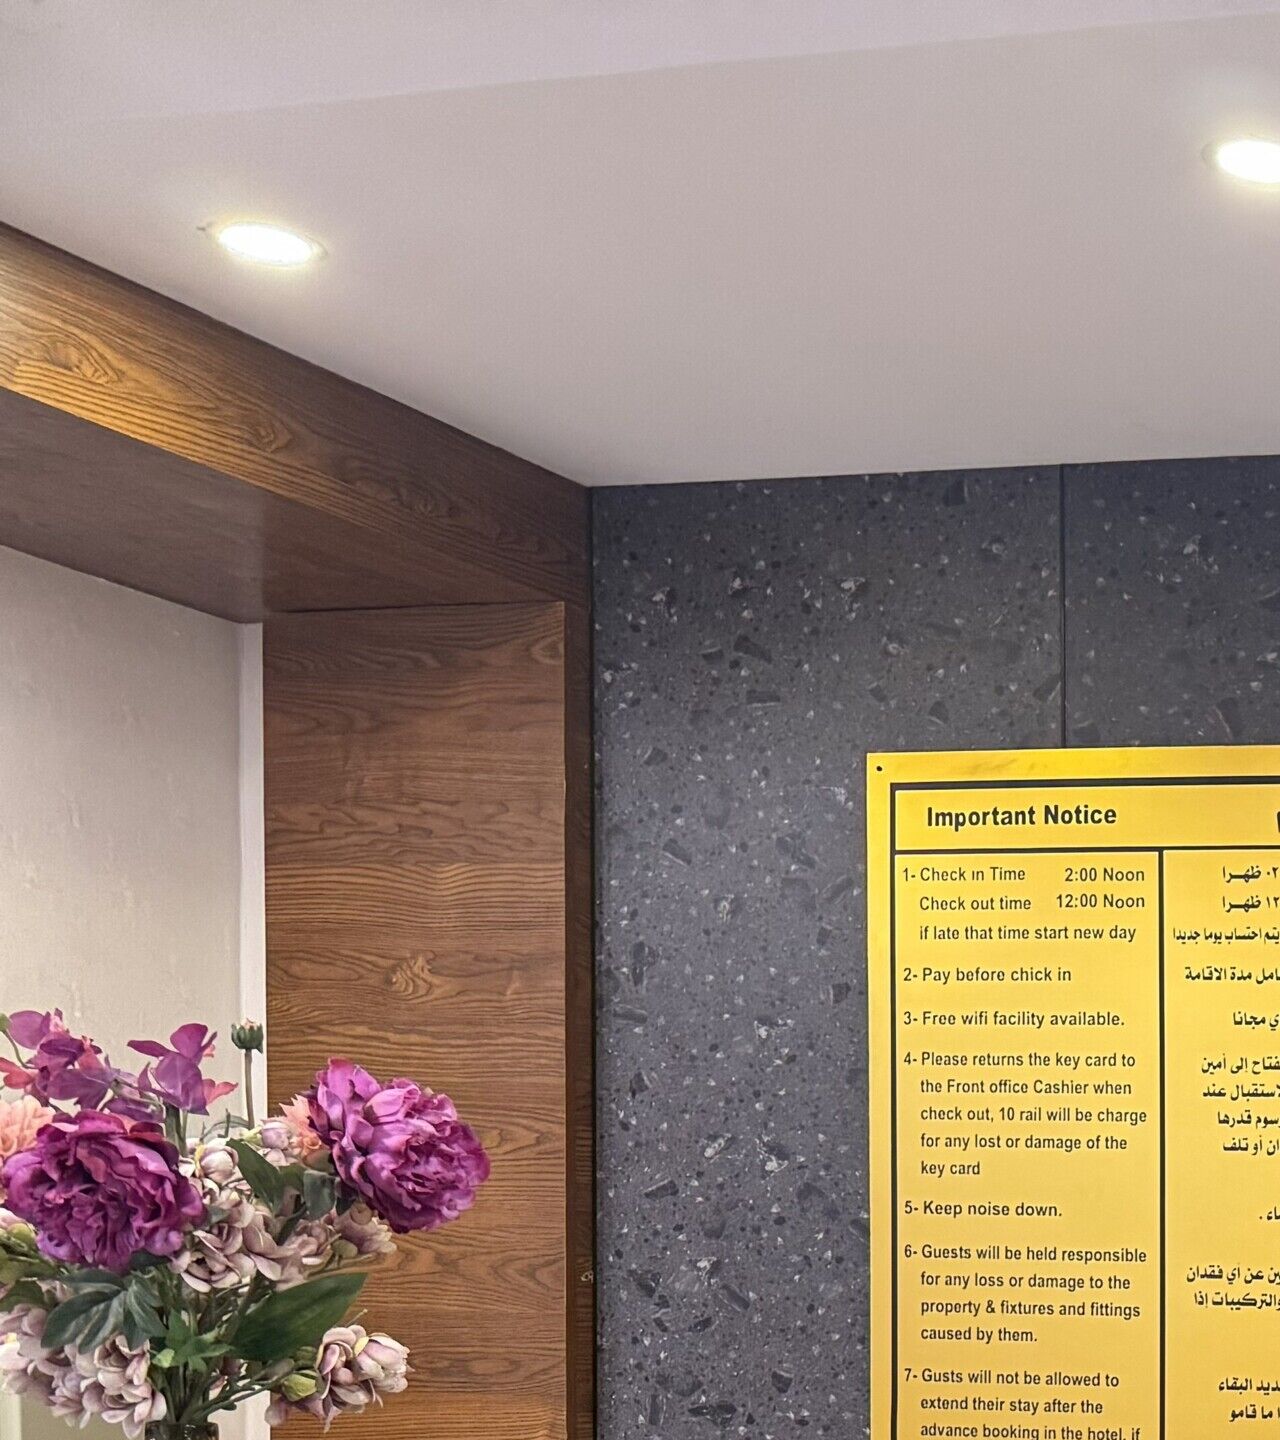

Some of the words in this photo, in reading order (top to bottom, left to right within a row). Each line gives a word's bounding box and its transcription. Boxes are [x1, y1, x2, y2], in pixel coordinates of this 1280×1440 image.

[927, 805, 1036, 833] Important
[1043, 803, 1117, 825] Notice
[919, 866, 967, 882] Check
[971, 870, 985, 881] in
[989, 866, 1026, 881] Time
[1064, 867, 1098, 883] 2:00
[1103, 867, 1145, 882] Noon
[919, 895, 966, 911] Check
[970, 897, 995, 911] out
[999, 895, 1032, 911] time
[1056, 893, 1098, 909] 12:00
[1103, 893, 1145, 909] Noon
[919, 925, 930, 941] if
[933, 925, 960, 940] late
[964, 925, 994, 940] that
[997, 925, 1030, 940] time
[1034, 926, 1069, 940] start
[1073, 928, 1105, 940] new
[1108, 924, 1137, 943] day
[922, 967, 951, 986] Pay
[956, 966, 1006, 982] before
[1010, 966, 1053, 982] chick
[1057, 966, 1072, 982] in
[922, 1010, 957, 1026] Free
[960, 1010, 988, 1026] wifi
[993, 1010, 1045, 1030] facility
[1049, 1011, 1125, 1026] available.
[1232, 1010, 1267, 1030] مجانا
[921, 1051, 968, 1067] Please
[972, 1052, 1024, 1067] returns
[1028, 1051, 1051, 1067] the
[1055, 1051, 1081, 1071] key
[1084, 1052, 1117, 1067] card
[1121, 1053, 1136, 1068] to
[920, 1078, 943, 1093] the
[947, 1078, 985, 1094] Front
[989, 1078, 1029, 1094] office
[1033, 1079, 1090, 1095] Cashier
[1092, 1080, 1132, 1095] when
[1202, 1083, 1227, 1098] عند
[920, 1105, 963, 1121] check
[966, 1107, 994, 1123] out,
[998, 1106, 1015, 1121] 10
[1019, 1106, 1042, 1122] rail
[1046, 1106, 1071, 1122] will
[1075, 1107, 1093, 1122] be
[1097, 1107, 1147, 1127] charge
[920, 1133, 941, 1148] for
[944, 1136, 971, 1152] any
[974, 1133, 1002, 1149] lost
[1005, 1137, 1021, 1149] or
[1024, 1134, 1082, 1153] damage
[1086, 1134, 1102, 1150] of
[1104, 1135, 1128, 1150] the
[920, 1160, 946, 1179] key
[949, 1160, 981, 1176] card
[923, 1200, 963, 1219] Keep
[967, 1200, 1010, 1217] noise
[1014, 1201, 1063, 1217] down.
[921, 1243, 972, 1260] Guests
[975, 1244, 1000, 1260] will
[1004, 1245, 1022, 1261] be
[1026, 1245, 1057, 1261] held
[1061, 1247, 1147, 1266] responsible
[920, 1271, 942, 1286] for
[944, 1274, 971, 1290] any
[974, 1271, 1005, 1287] loss
[1008, 1276, 1025, 1288] or
[1027, 1273, 1085, 1293] damage
[1089, 1275, 1104, 1289] to
[1107, 1274, 1131, 1290] the
[920, 1300, 981, 1318] property
[985, 1299, 996, 1314] &
[1000, 1299, 1055, 1316] fixtures
[1058, 1301, 1086, 1316] and
[1090, 1301, 1141, 1321] fittings
[920, 1326, 972, 1341] caused
[976, 1326, 994, 1345] by
[997, 1326, 1038, 1342] them.
[921, 1367, 964, 1384] Gusts
[967, 1369, 992, 1384] will
[996, 1371, 1020, 1385] not
[1023, 1370, 1041, 1385] be
[1045, 1371, 1101, 1387] allowed
[1104, 1373, 1120, 1388] to
[920, 1396, 969, 1411] extend
[972, 1396, 1006, 1412] their
[1009, 1398, 1040, 1416] stay
[1043, 1398, 1078, 1414] after
[1080, 1398, 1104, 1415] the
[920, 1423, 979, 1438] advance
[1044, 1425, 1057, 1440] in
[1060, 1425, 1083, 1440] the
